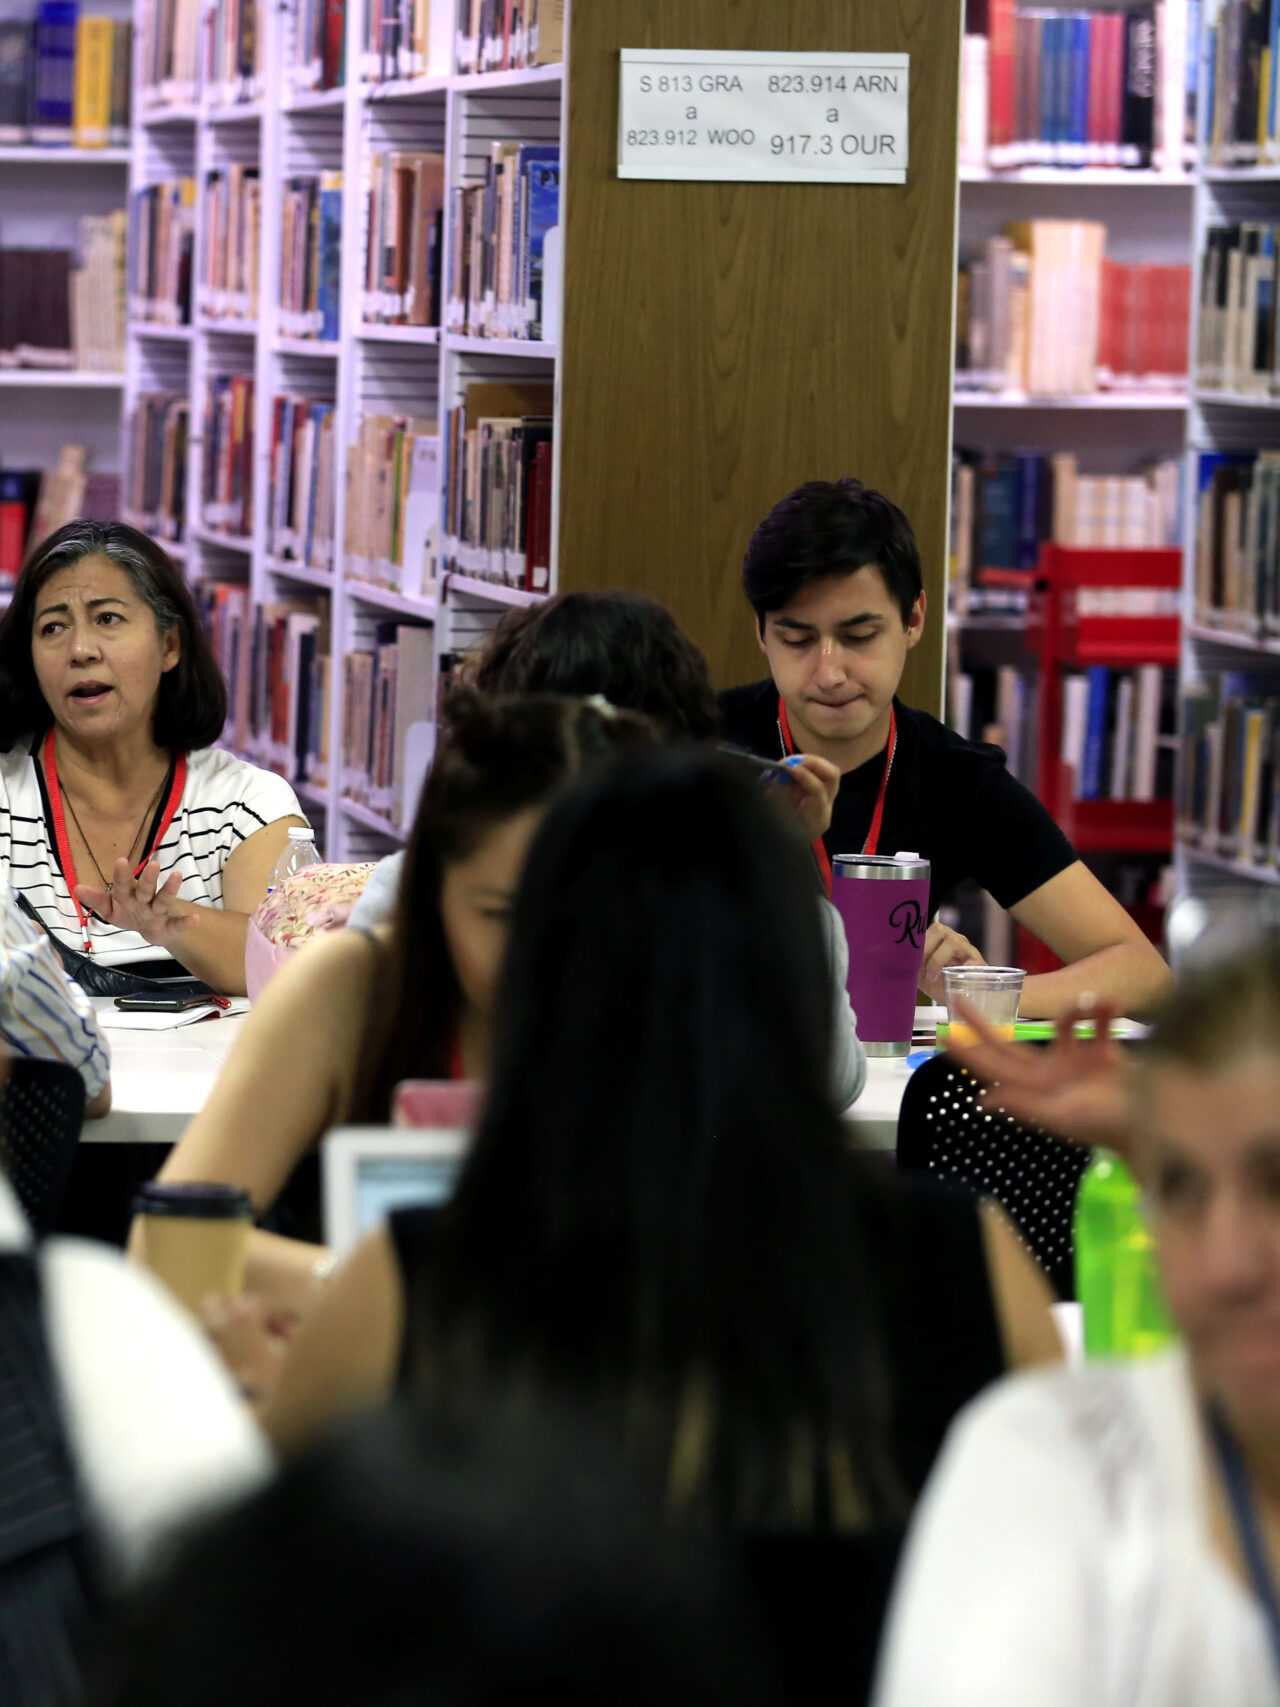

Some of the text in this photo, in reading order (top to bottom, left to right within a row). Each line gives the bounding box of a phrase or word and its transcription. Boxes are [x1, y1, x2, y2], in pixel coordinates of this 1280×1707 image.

[640, 75, 743, 93] S 813 GRA
[768, 75, 898, 93] 823.914 ARN
[685, 106, 698, 121] a
[826, 107, 839, 123] a
[626, 128, 756, 146] 823.912 WOO
[770, 134, 896, 155] 917.3 OUR
